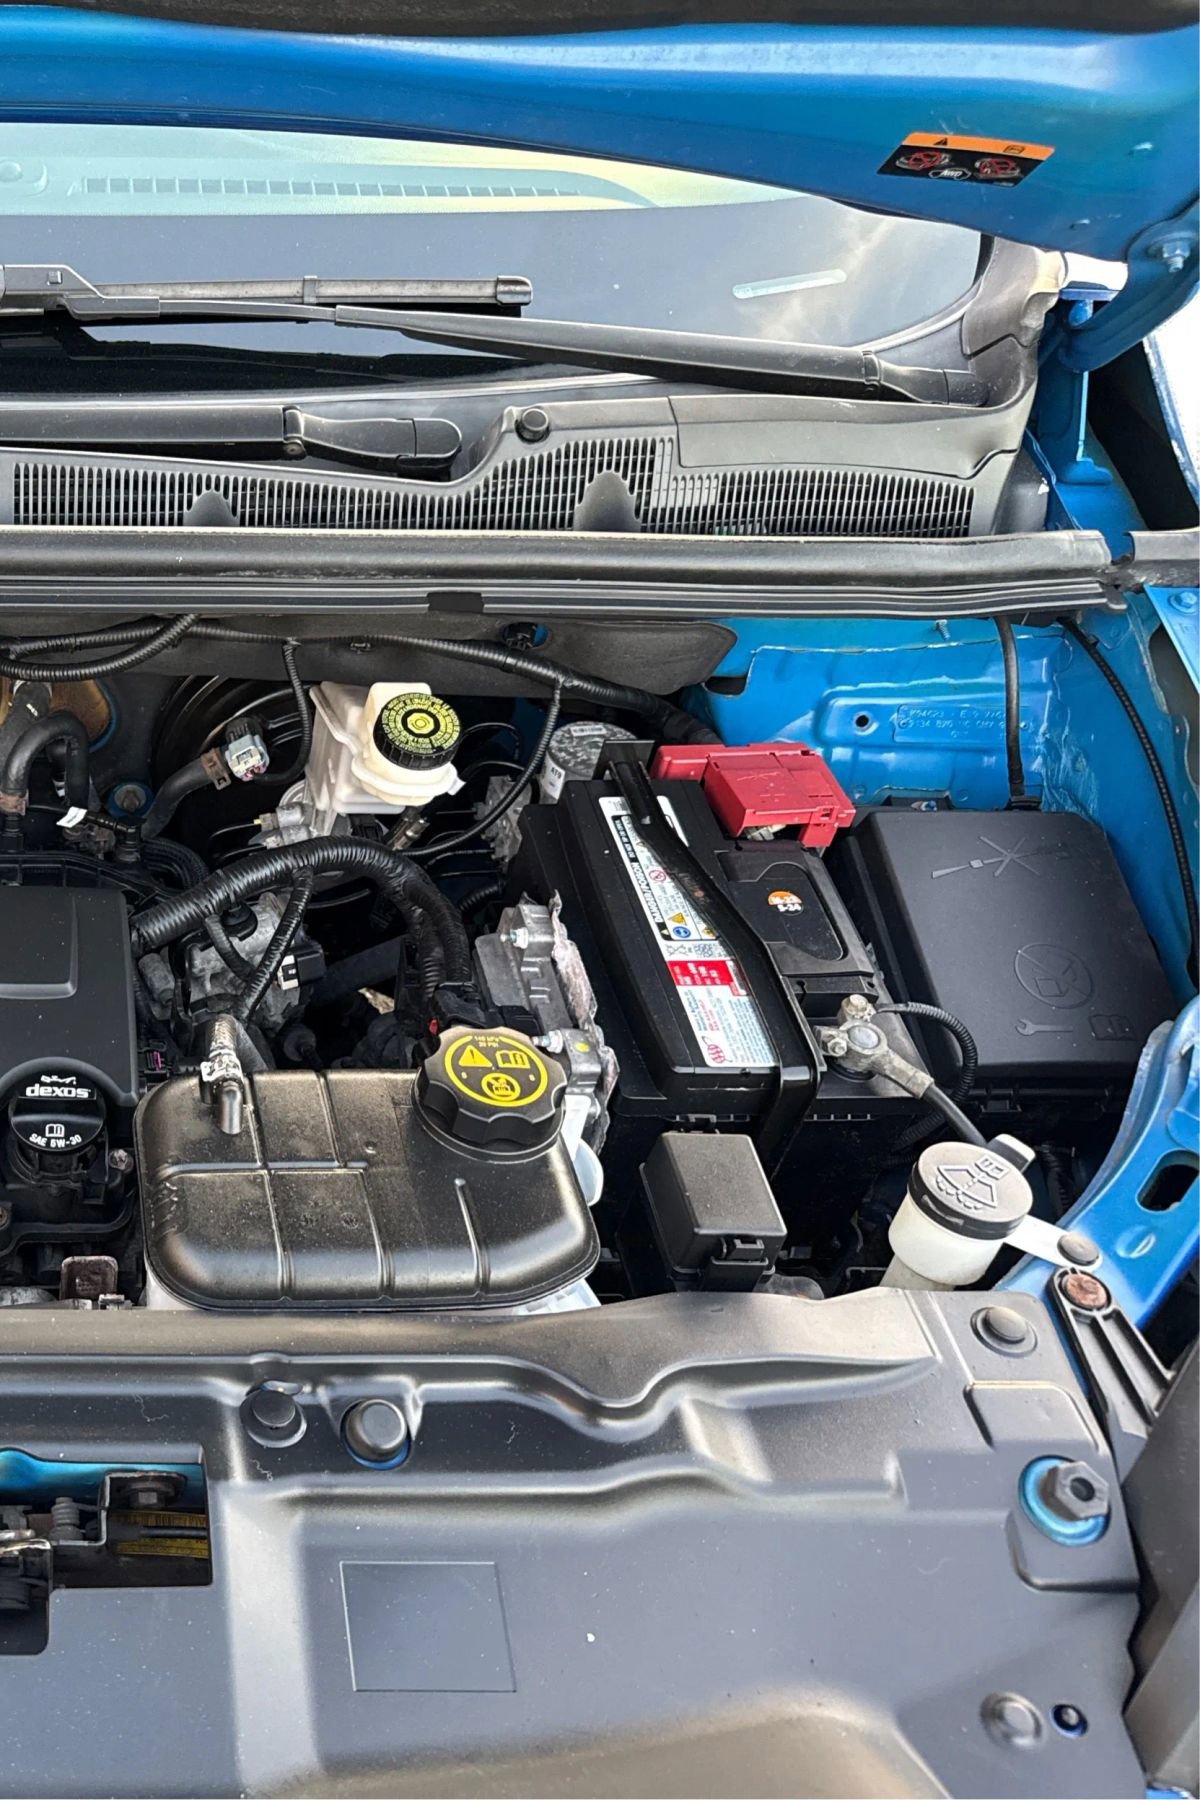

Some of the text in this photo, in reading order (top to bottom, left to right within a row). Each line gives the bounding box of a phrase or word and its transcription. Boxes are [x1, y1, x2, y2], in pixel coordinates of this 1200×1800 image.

[631, 862, 664, 923] DANGER/POISON
[25, 1083, 89, 1098] dexos
[29, 1133, 82, 1148] SAE 5W-30
